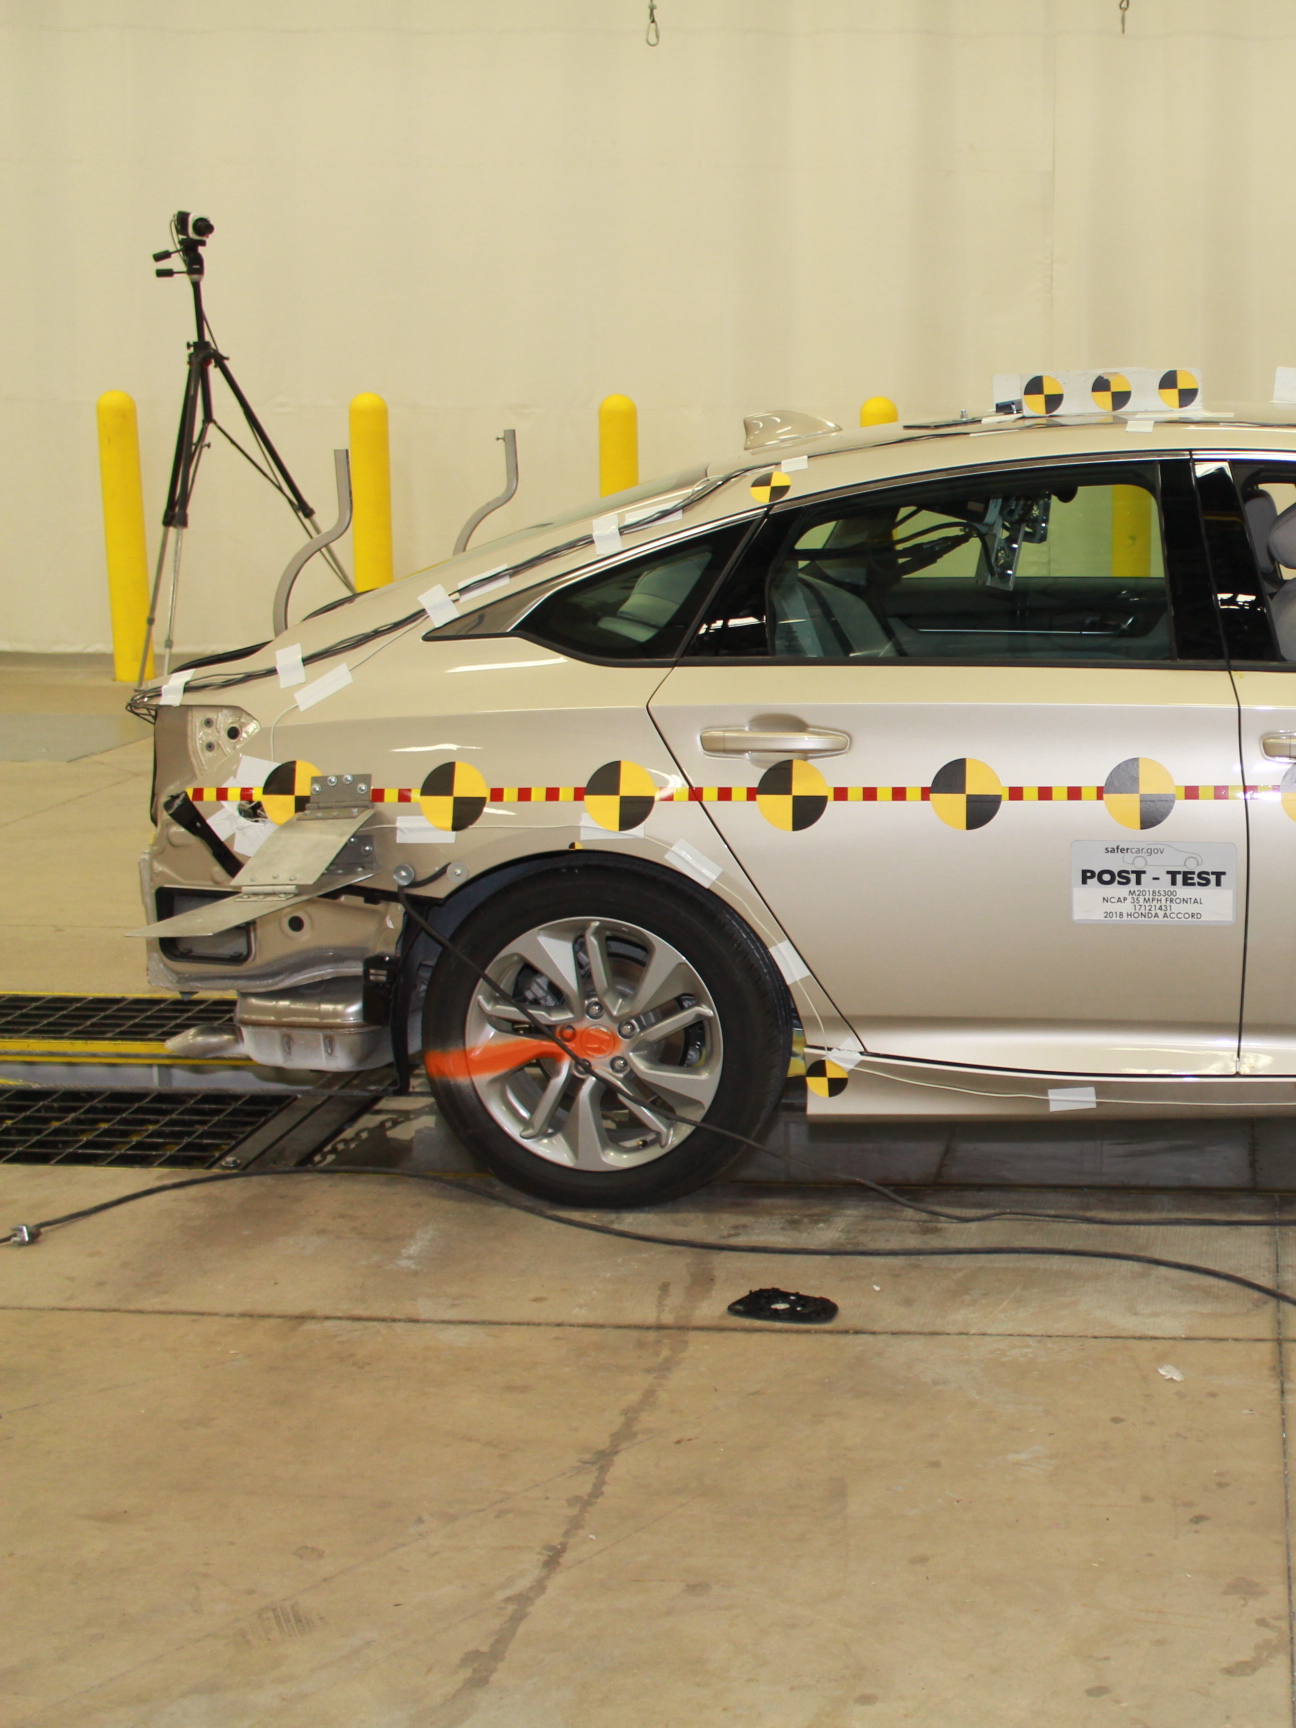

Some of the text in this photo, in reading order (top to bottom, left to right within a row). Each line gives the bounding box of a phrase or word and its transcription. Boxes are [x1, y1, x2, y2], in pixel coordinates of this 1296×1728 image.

[1104, 844, 1165, 856] safercar.gov
[1081, 869, 1146, 886] POST
[1166, 870, 1227, 887] TEST
[1143, 897, 1162, 905] MPH
[1165, 897, 1203, 905] FRONTAL
[1133, 904, 1173, 912] 17121431
[1163, 912, 1202, 920] ACCORD
